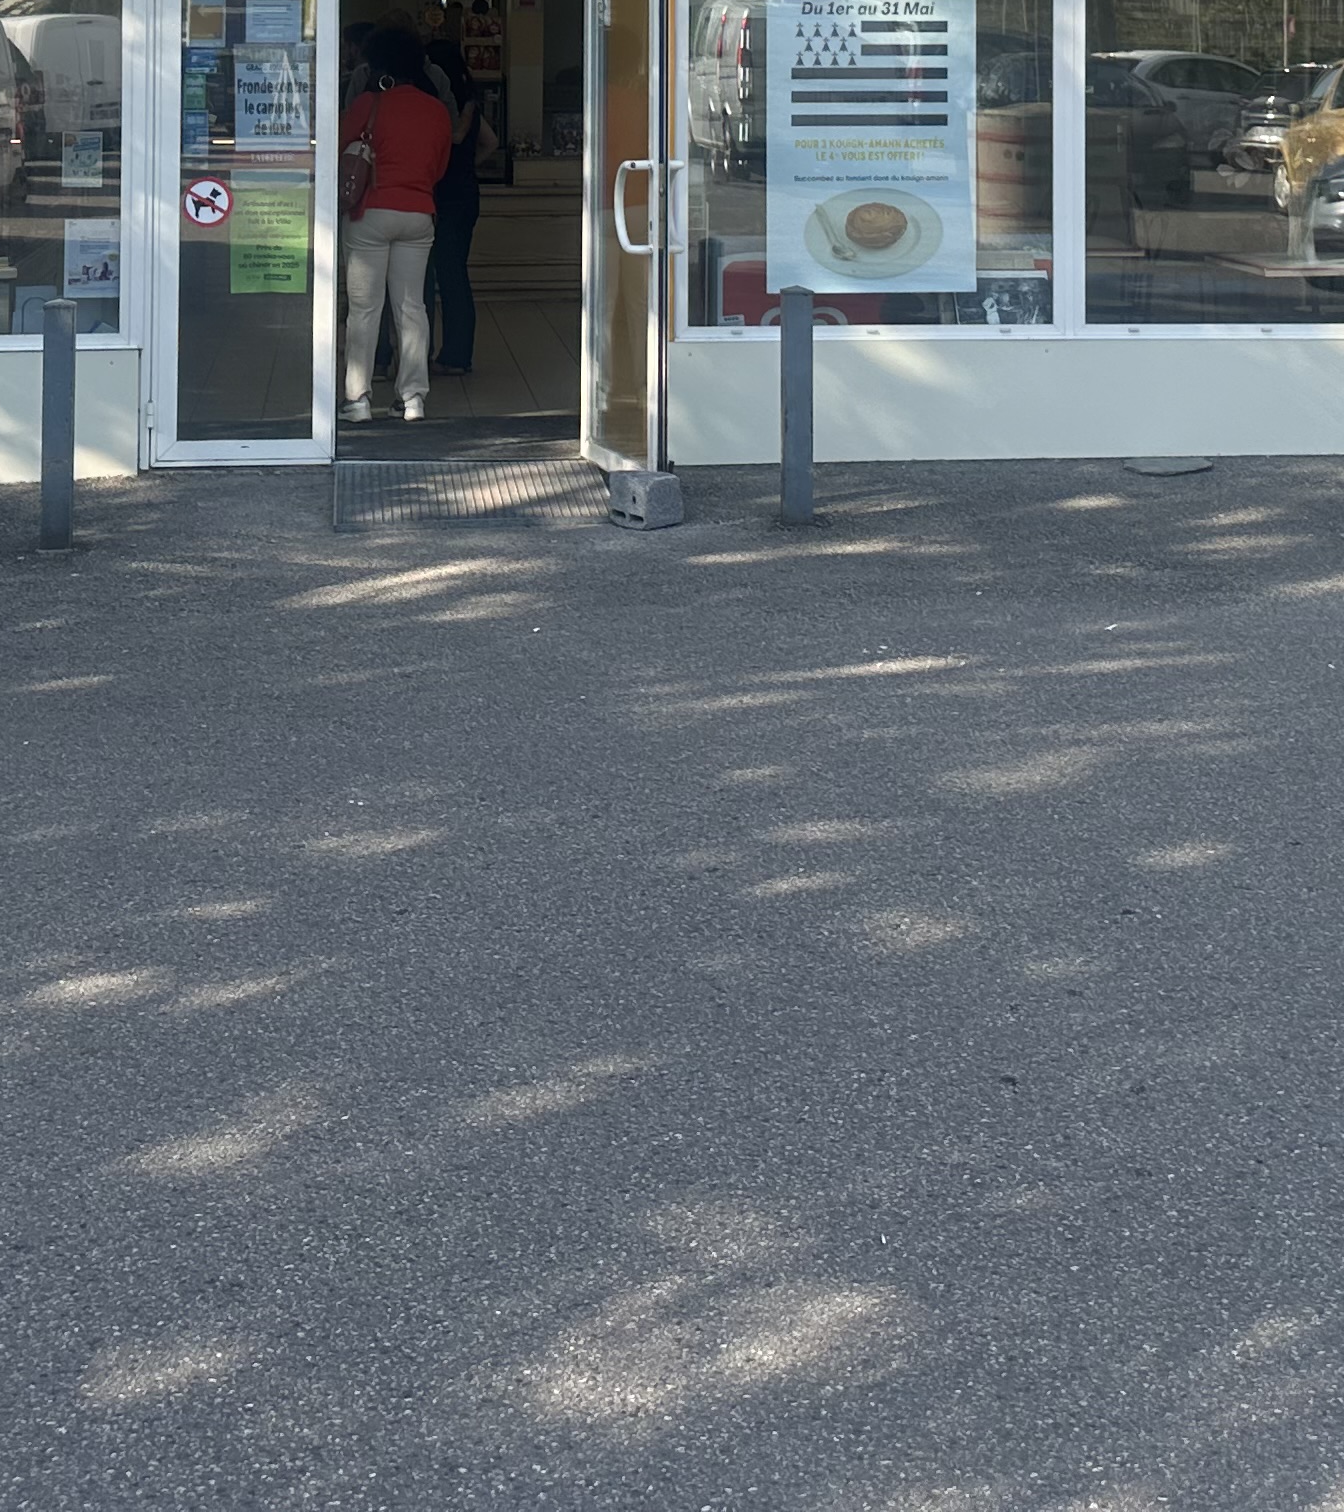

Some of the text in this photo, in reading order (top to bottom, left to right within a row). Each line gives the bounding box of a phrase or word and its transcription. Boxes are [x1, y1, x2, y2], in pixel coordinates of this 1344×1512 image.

[801, 1, 936, 16] Du 1er au 31 Mai
[237, 76, 273, 94] Fronde
[244, 98, 254, 115] le
[794, 139, 819, 149] POUR
[816, 151, 826, 161] LE
[841, 151, 866, 161] VOUS
[868, 151, 885, 161] EST
